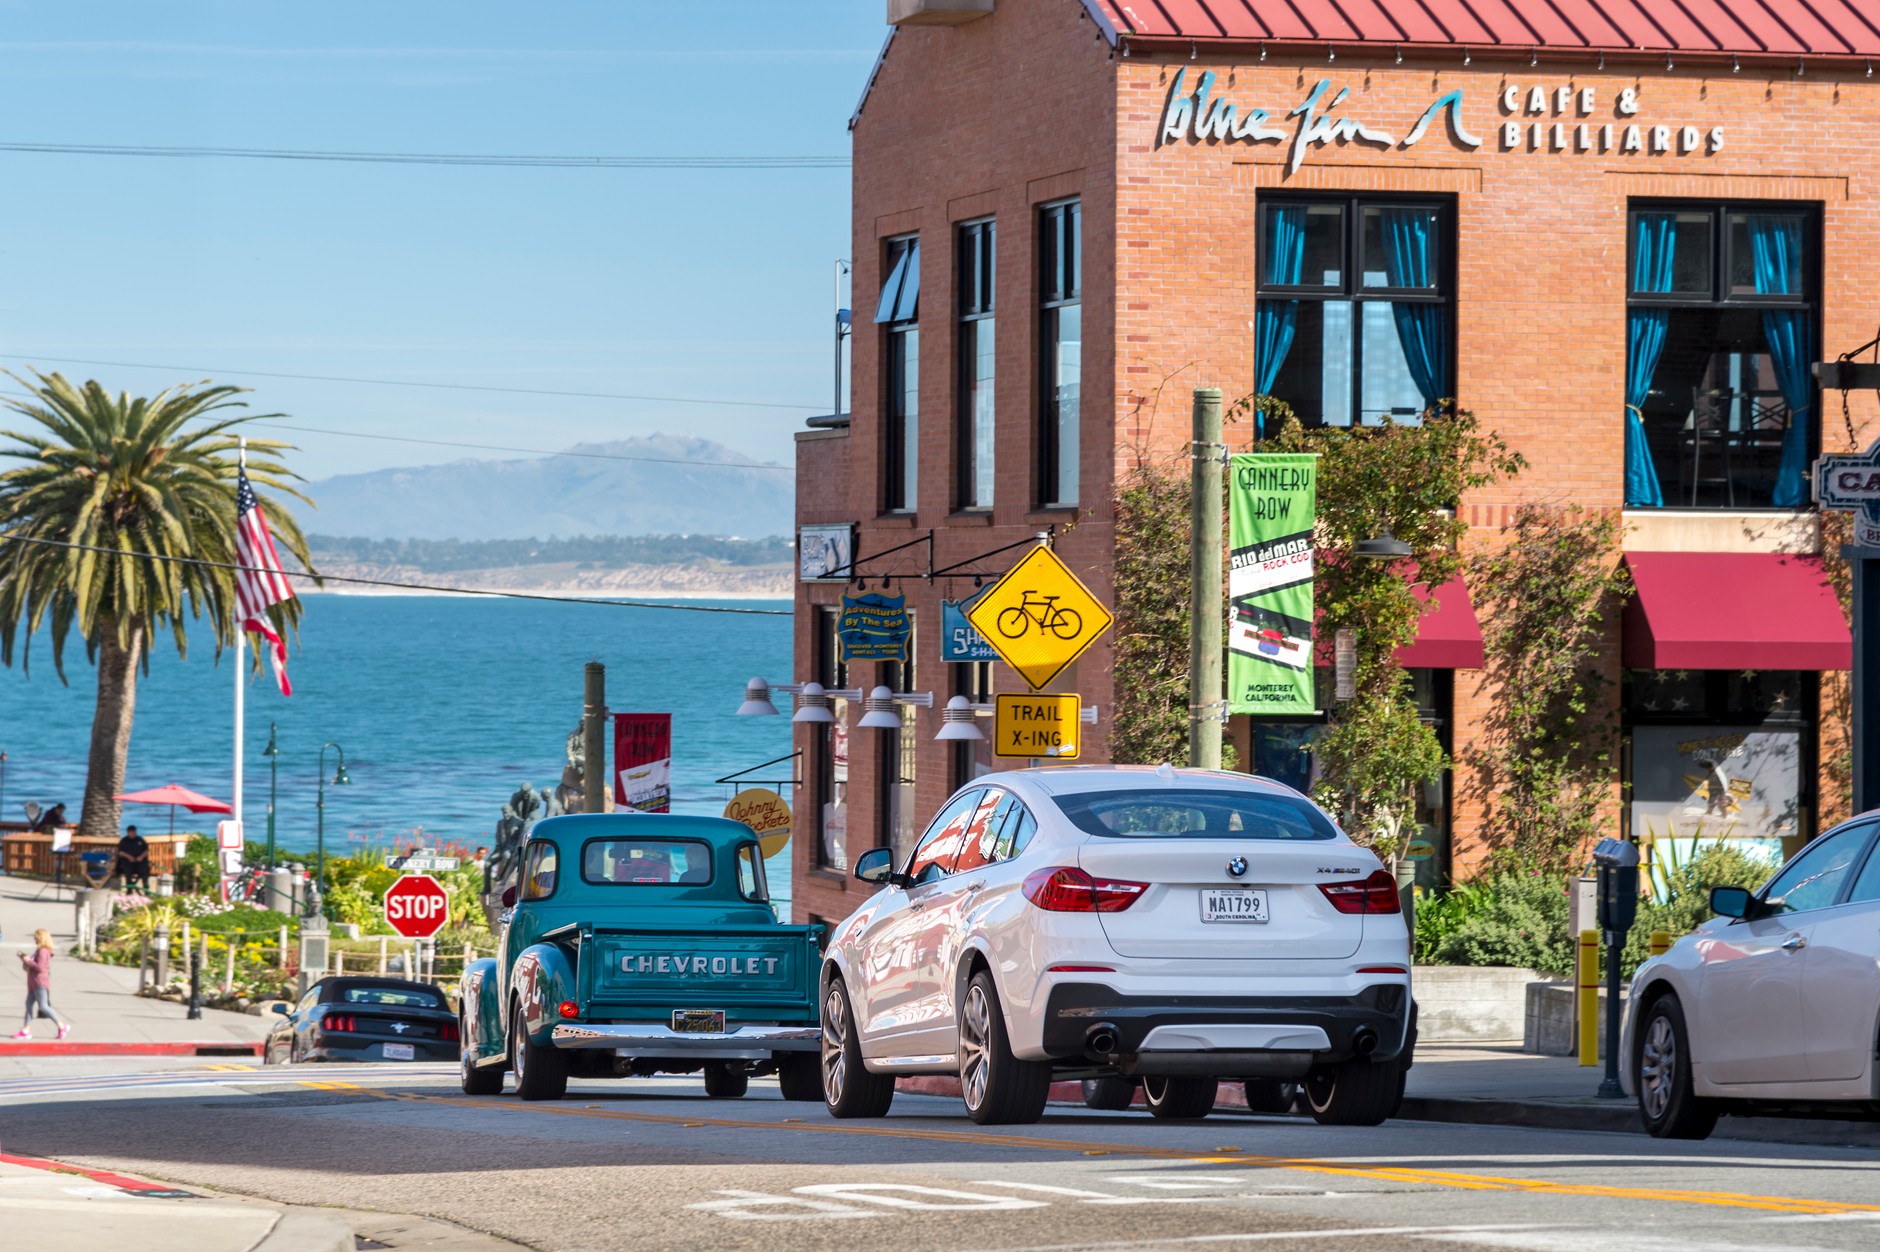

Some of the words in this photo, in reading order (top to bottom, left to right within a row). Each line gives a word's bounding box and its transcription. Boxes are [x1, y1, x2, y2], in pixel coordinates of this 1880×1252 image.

[1504, 85, 1595, 113] CAFE
[1619, 88, 1639, 114] &
[1160, 64, 1288, 145] blue
[1291, 78, 1395, 174] fin
[1505, 121, 1724, 152] BILLIARDS
[1238, 467, 1310, 491] CANNERY
[1254, 496, 1292, 521] ROW
[1231, 551, 1257, 570] RIO
[1273, 539, 1309, 560] MAR
[1263, 558, 1289, 571] ROCK
[1290, 552, 1310, 564] COD
[844, 605, 903, 616] Adventures
[844, 618, 859, 627] By
[861, 617, 881, 627] The
[883, 618, 903, 628] Sea
[1245, 693, 1297, 703] CALIFORNIA
[1247, 684, 1294, 693] MONTEREY
[1011, 705, 1063, 721] TRAIL
[1012, 731, 1062, 747] X-ING
[730, 799, 781, 820] Johnny
[388, 895, 445, 919] STOP
[1209, 897, 1260, 912] MA1799
[621, 955, 779, 975] CHEVROLET
